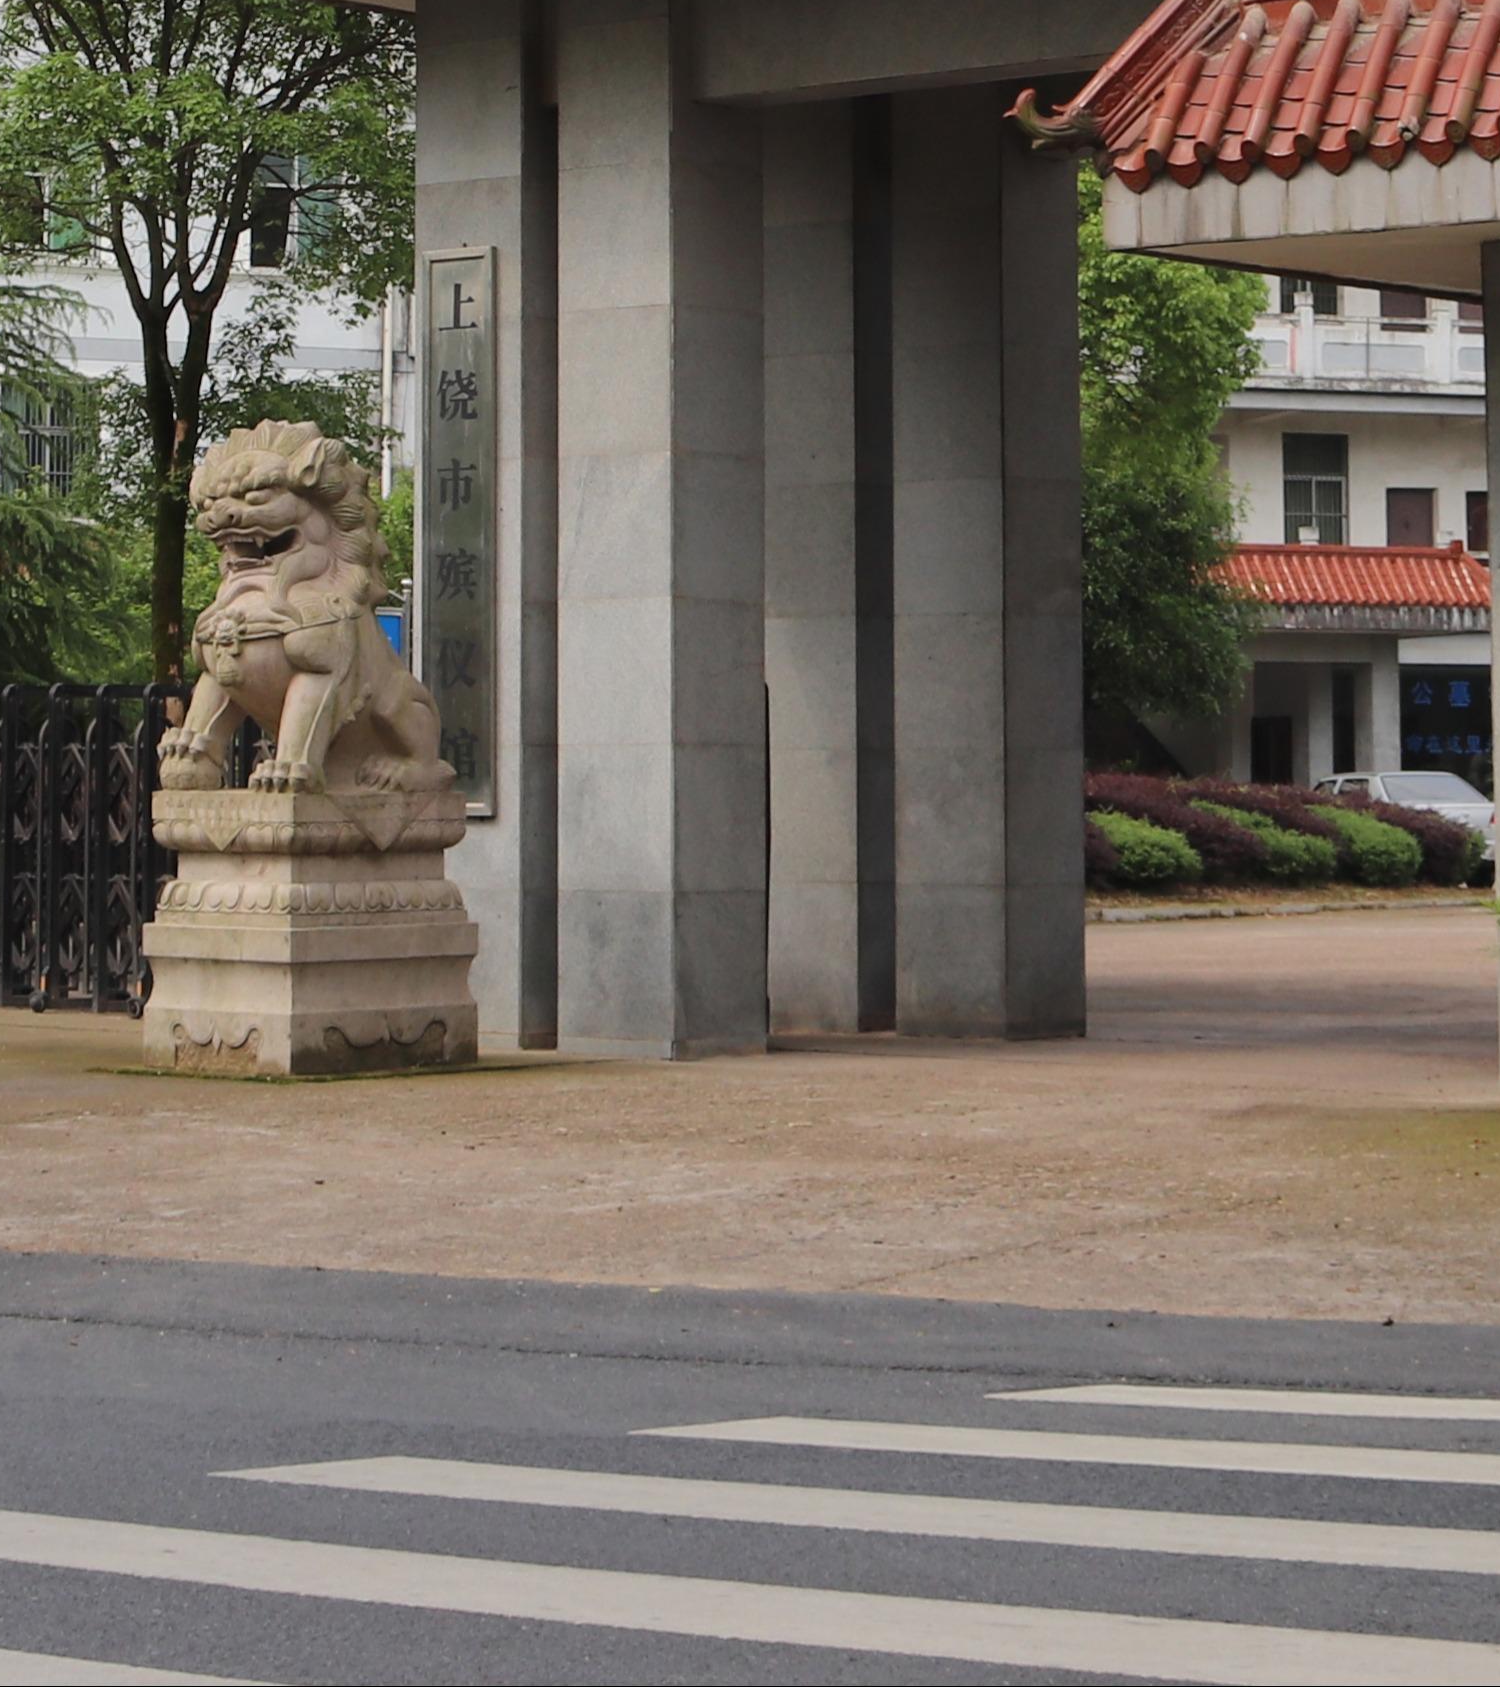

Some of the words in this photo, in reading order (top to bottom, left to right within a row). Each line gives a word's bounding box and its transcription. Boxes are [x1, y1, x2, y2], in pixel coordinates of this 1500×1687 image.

[436, 282, 478, 780] 上饶市殡仪馆
